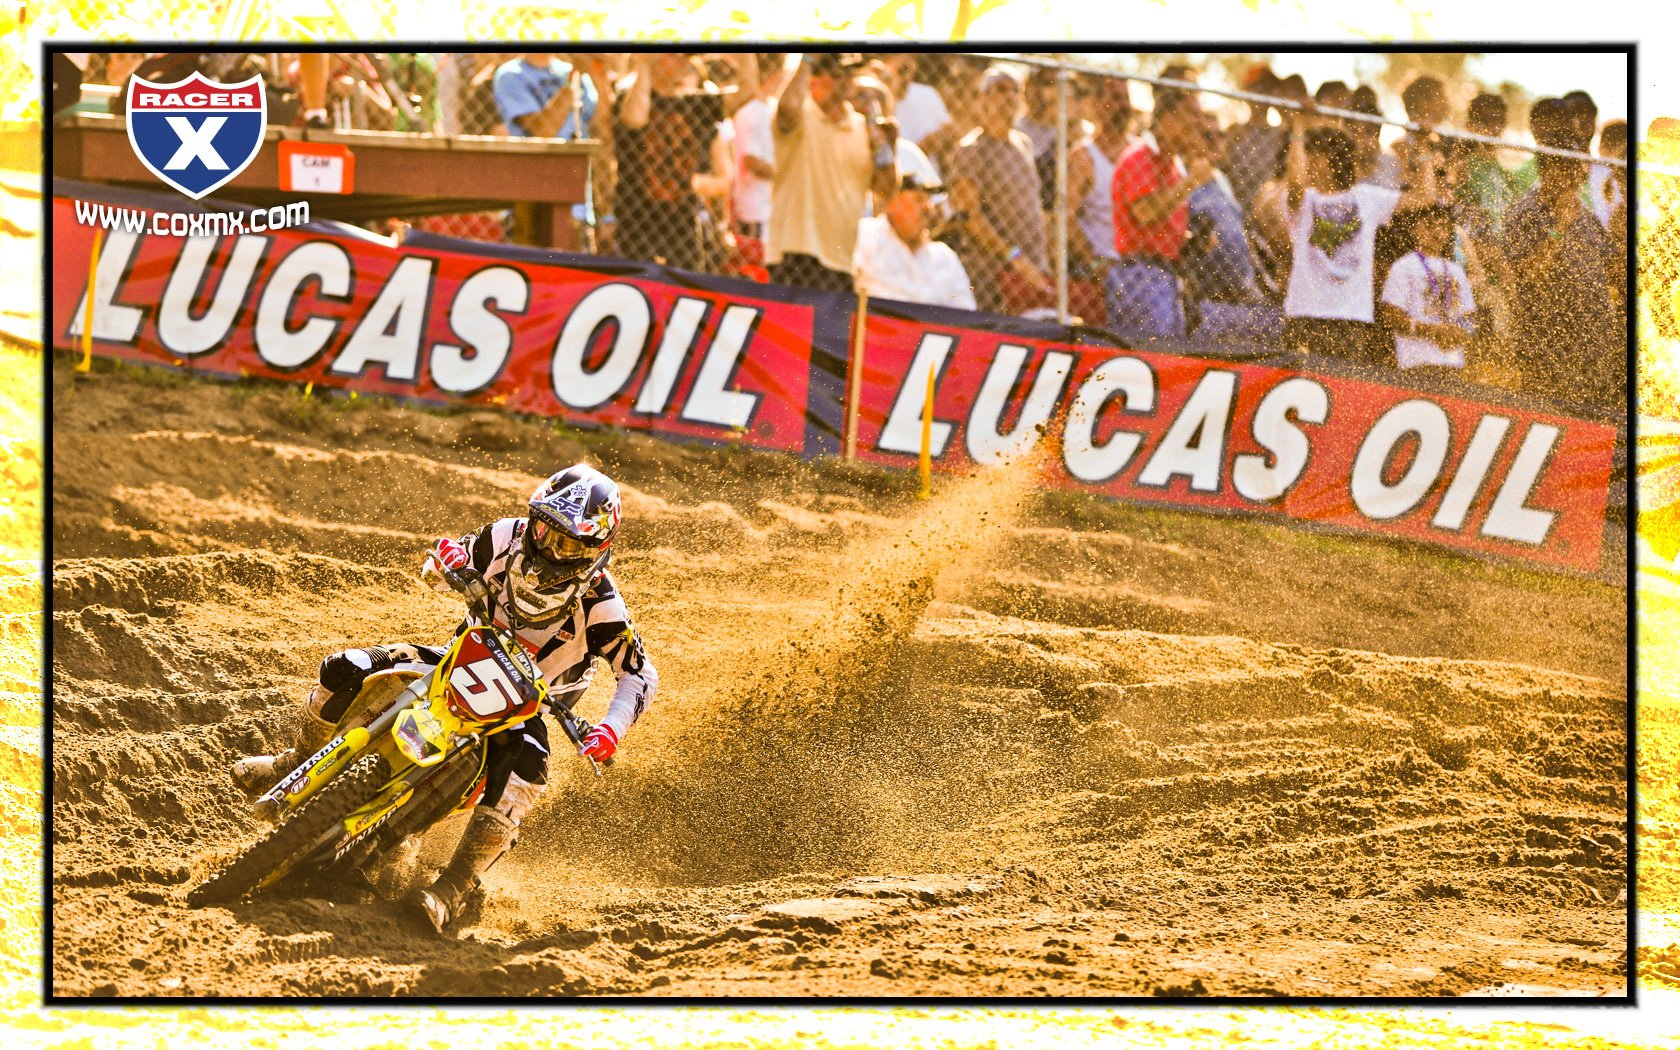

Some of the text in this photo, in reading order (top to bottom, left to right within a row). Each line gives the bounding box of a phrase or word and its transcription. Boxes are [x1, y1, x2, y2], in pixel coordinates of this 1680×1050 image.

[302, 157, 331, 168] CAM
[69, 233, 759, 428] LUCAS OIL
[876, 332, 1560, 546] LUCAS OIL
[449, 657, 524, 716] 5
[494, 649, 514, 671] LUCAS
[511, 668, 523, 683] OIL
[280, 735, 346, 789] DUNLOP
[334, 806, 398, 862] DUNLOP
